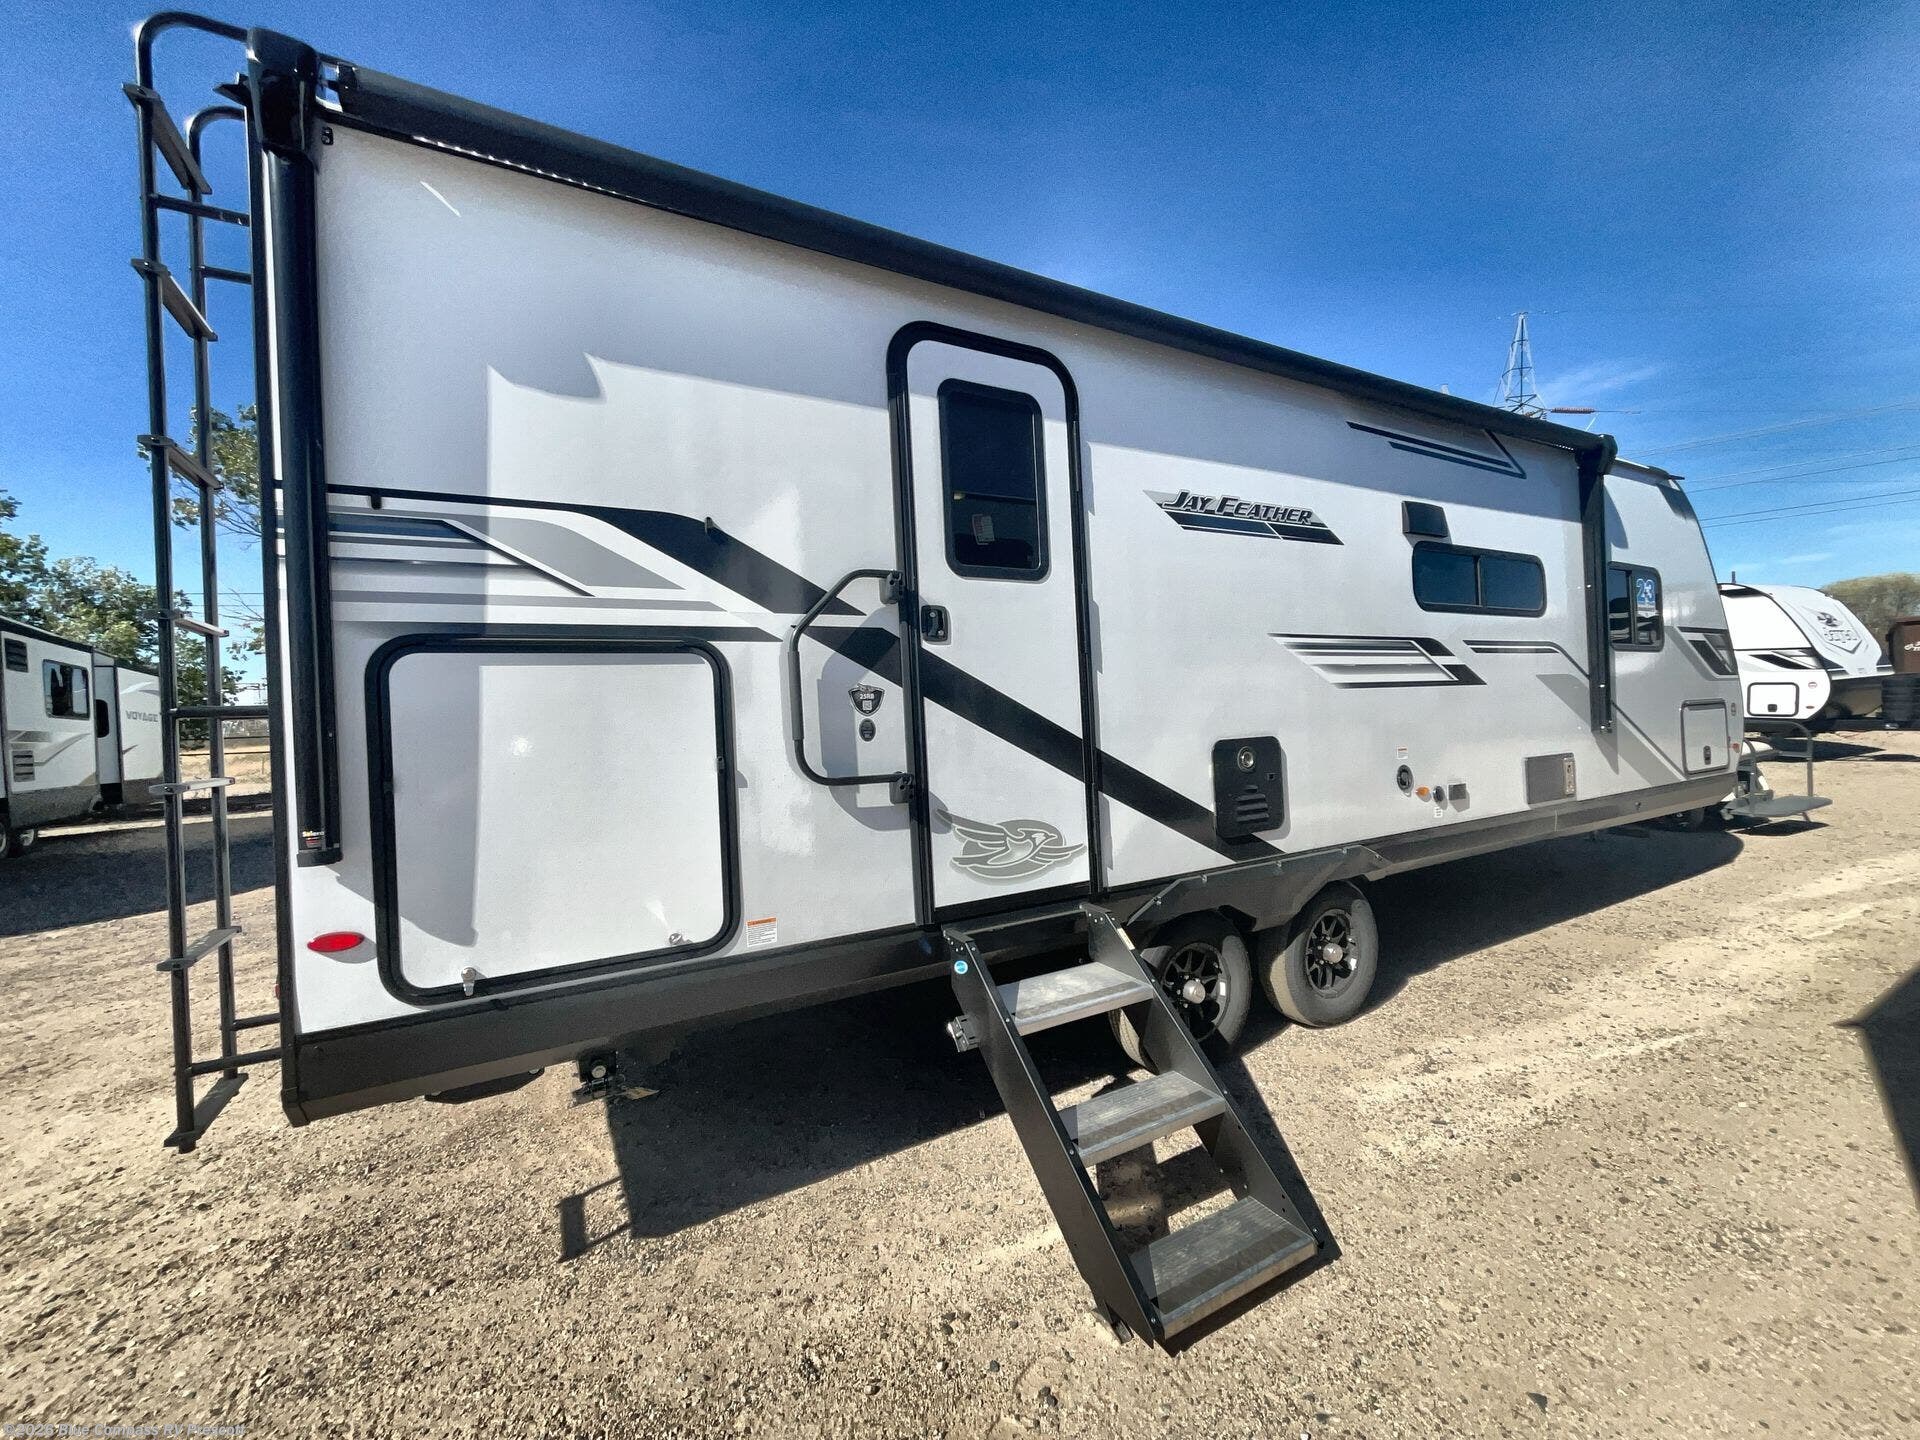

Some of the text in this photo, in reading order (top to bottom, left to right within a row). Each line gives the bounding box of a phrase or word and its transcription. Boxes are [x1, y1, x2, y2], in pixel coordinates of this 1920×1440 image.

[1161, 488, 1312, 525] JAY FEATHER
[1635, 577, 1656, 605] 23
[125, 709, 159, 723] VOYAGE
